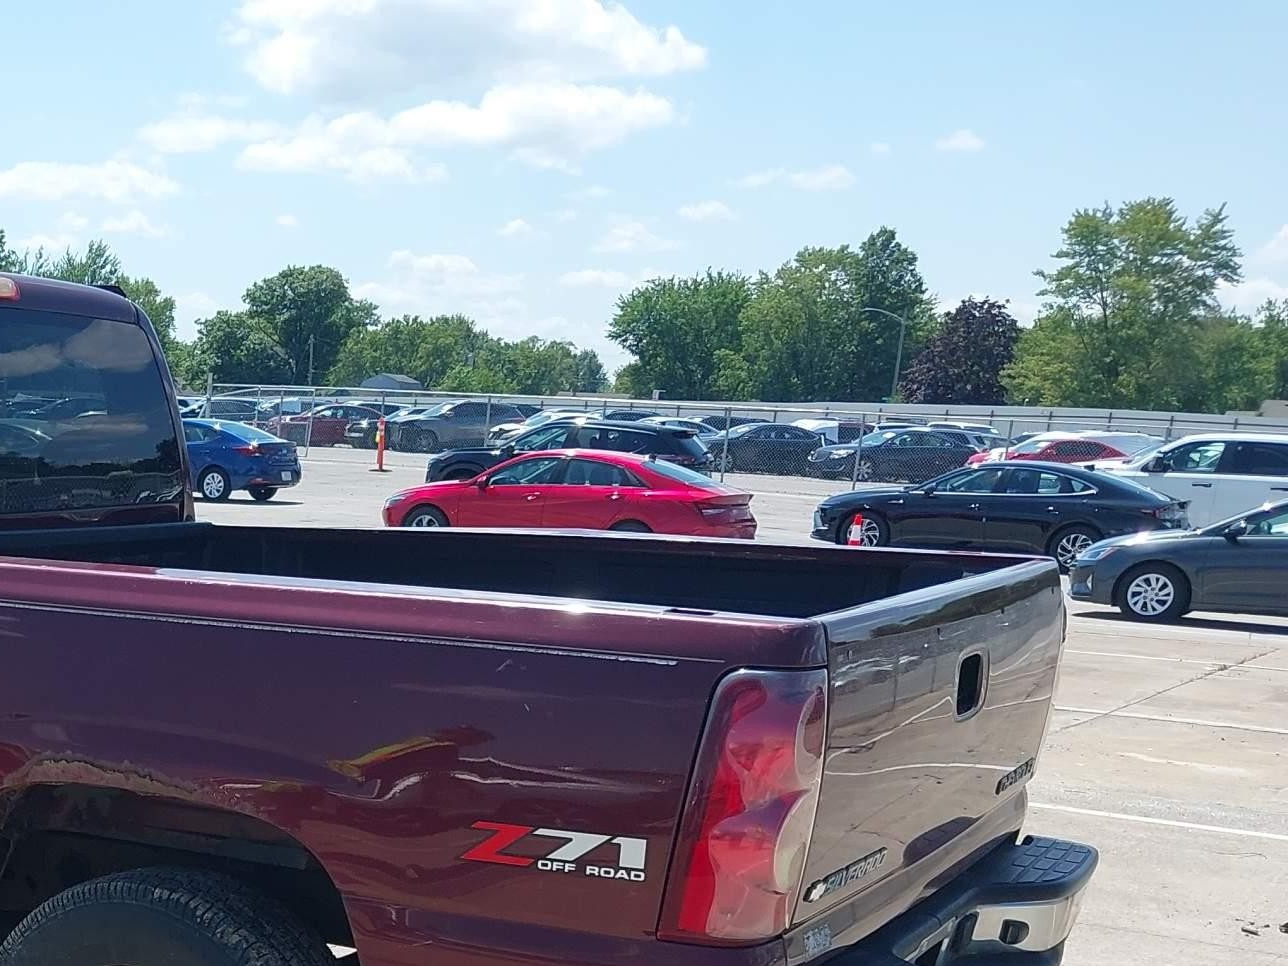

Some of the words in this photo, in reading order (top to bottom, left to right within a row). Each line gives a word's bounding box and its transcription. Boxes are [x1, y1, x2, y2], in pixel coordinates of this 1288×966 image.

[461, 821, 648, 870] Z71
[537, 860, 576, 873] OFF
[585, 865, 646, 882] ROAD
[823, 848, 888, 896] SILVERADO
